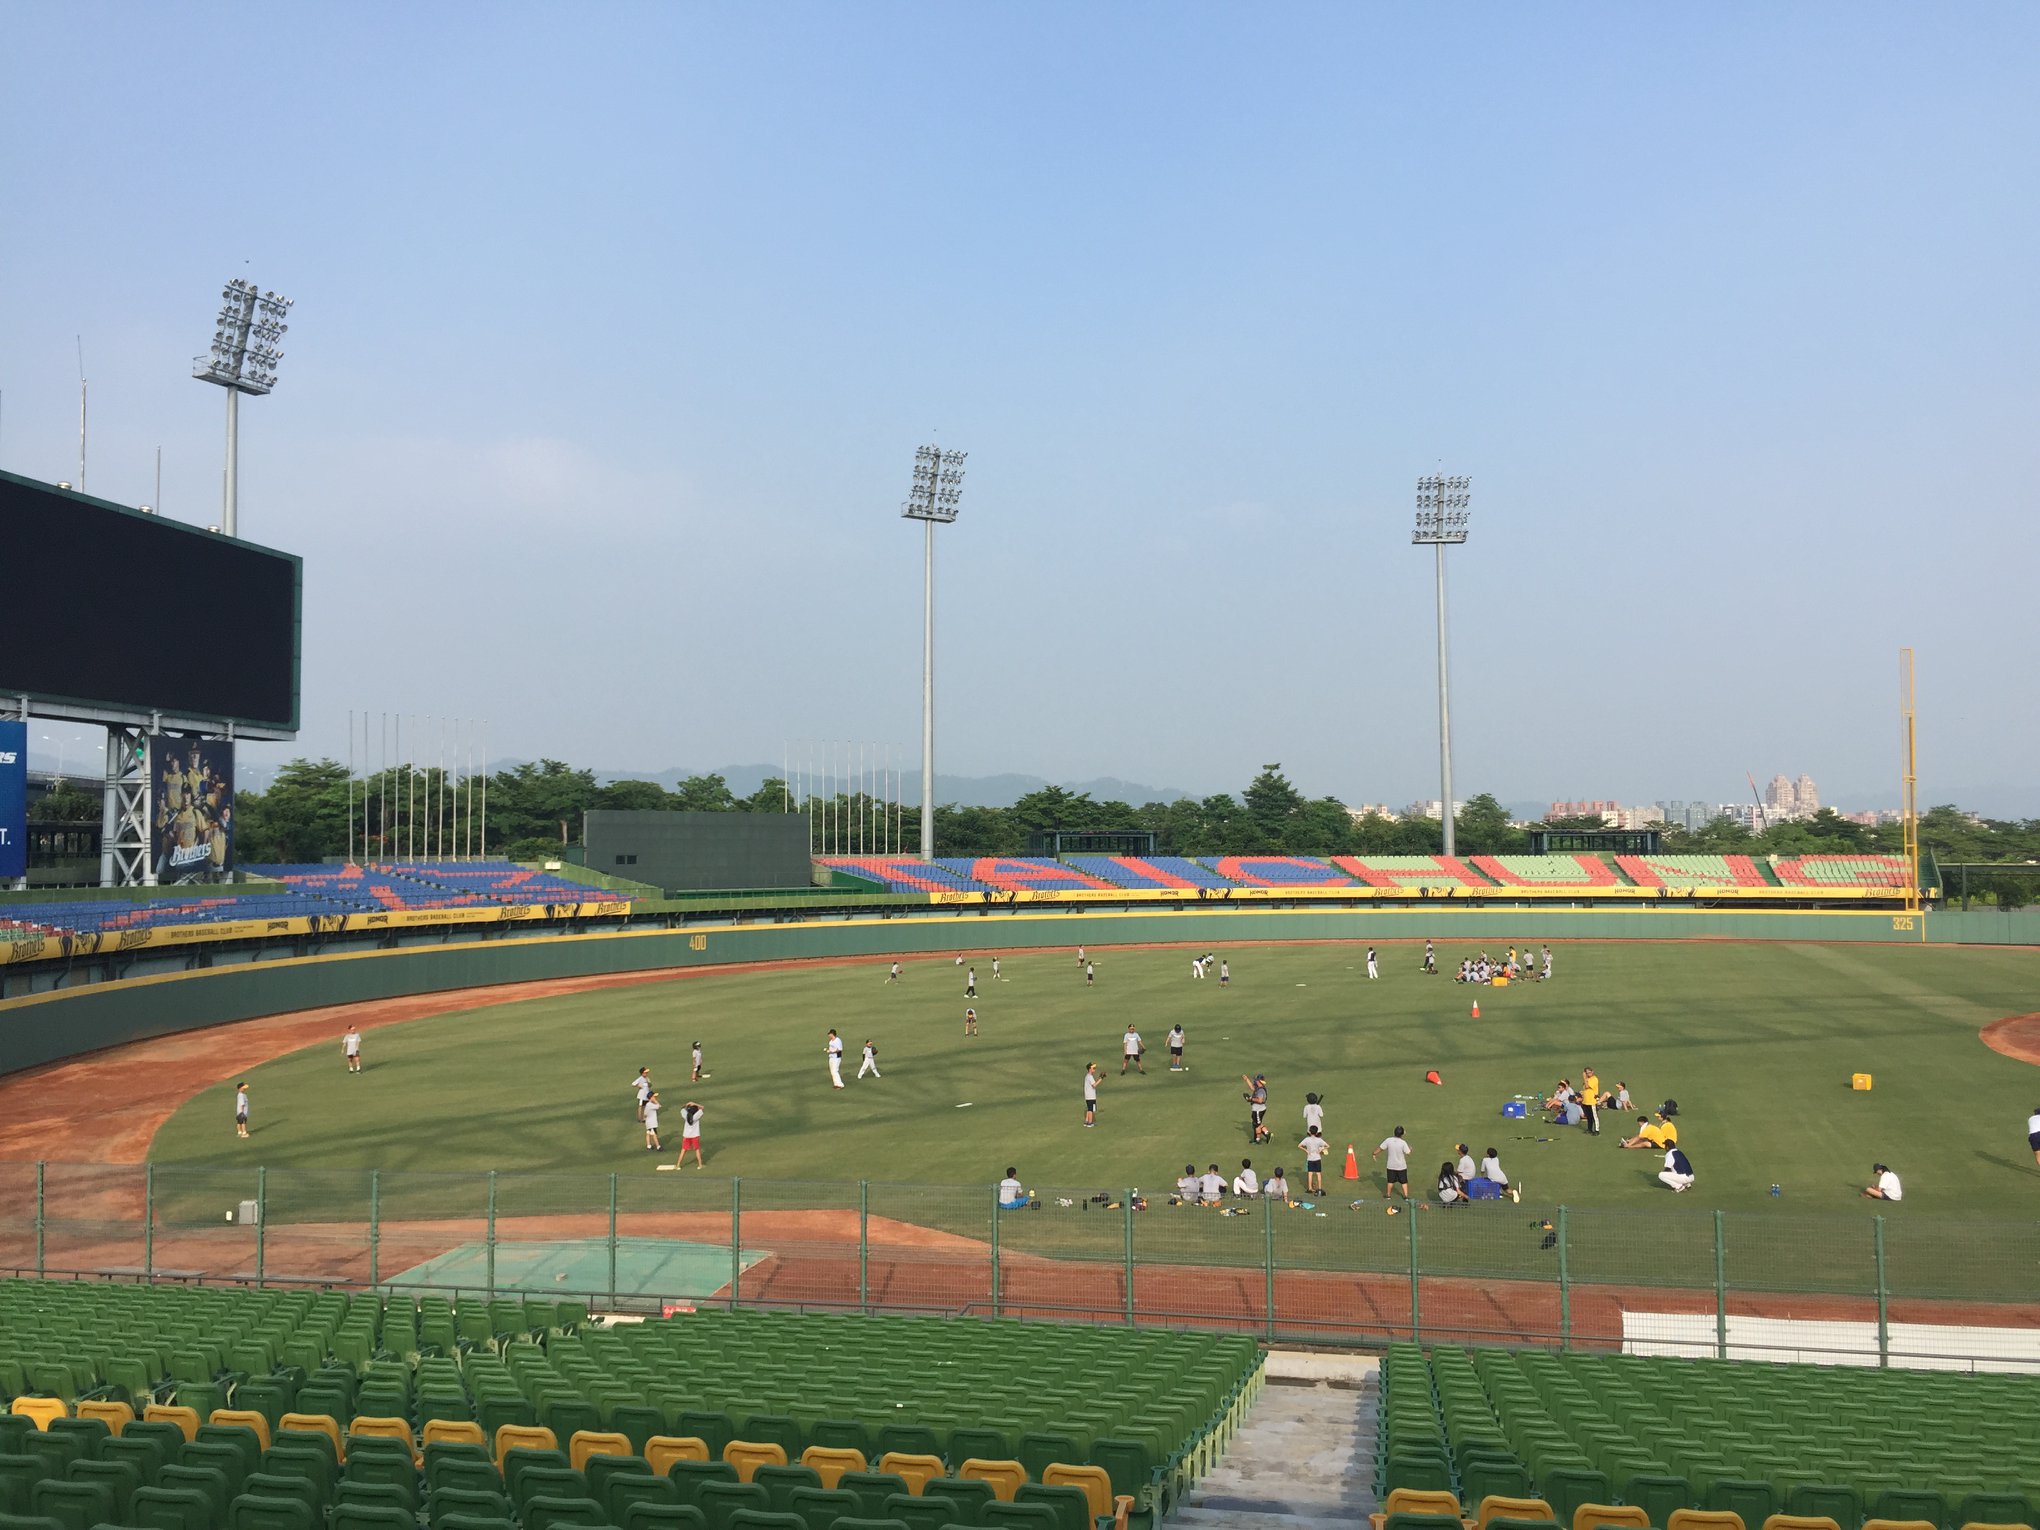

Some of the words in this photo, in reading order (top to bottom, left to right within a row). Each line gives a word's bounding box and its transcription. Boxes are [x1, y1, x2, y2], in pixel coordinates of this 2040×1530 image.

[169, 842, 212, 866] Brothers
[938, 891, 969, 903] Brothers
[497, 904, 531, 920] Brothers
[594, 900, 626, 916] Brothers
[1893, 916, 1913, 931] 325
[116, 927, 153, 950] Brothers
[170, 930, 194, 938] BROTHERS
[7, 939, 45, 963] Brothers
[689, 935, 707, 951] 400
